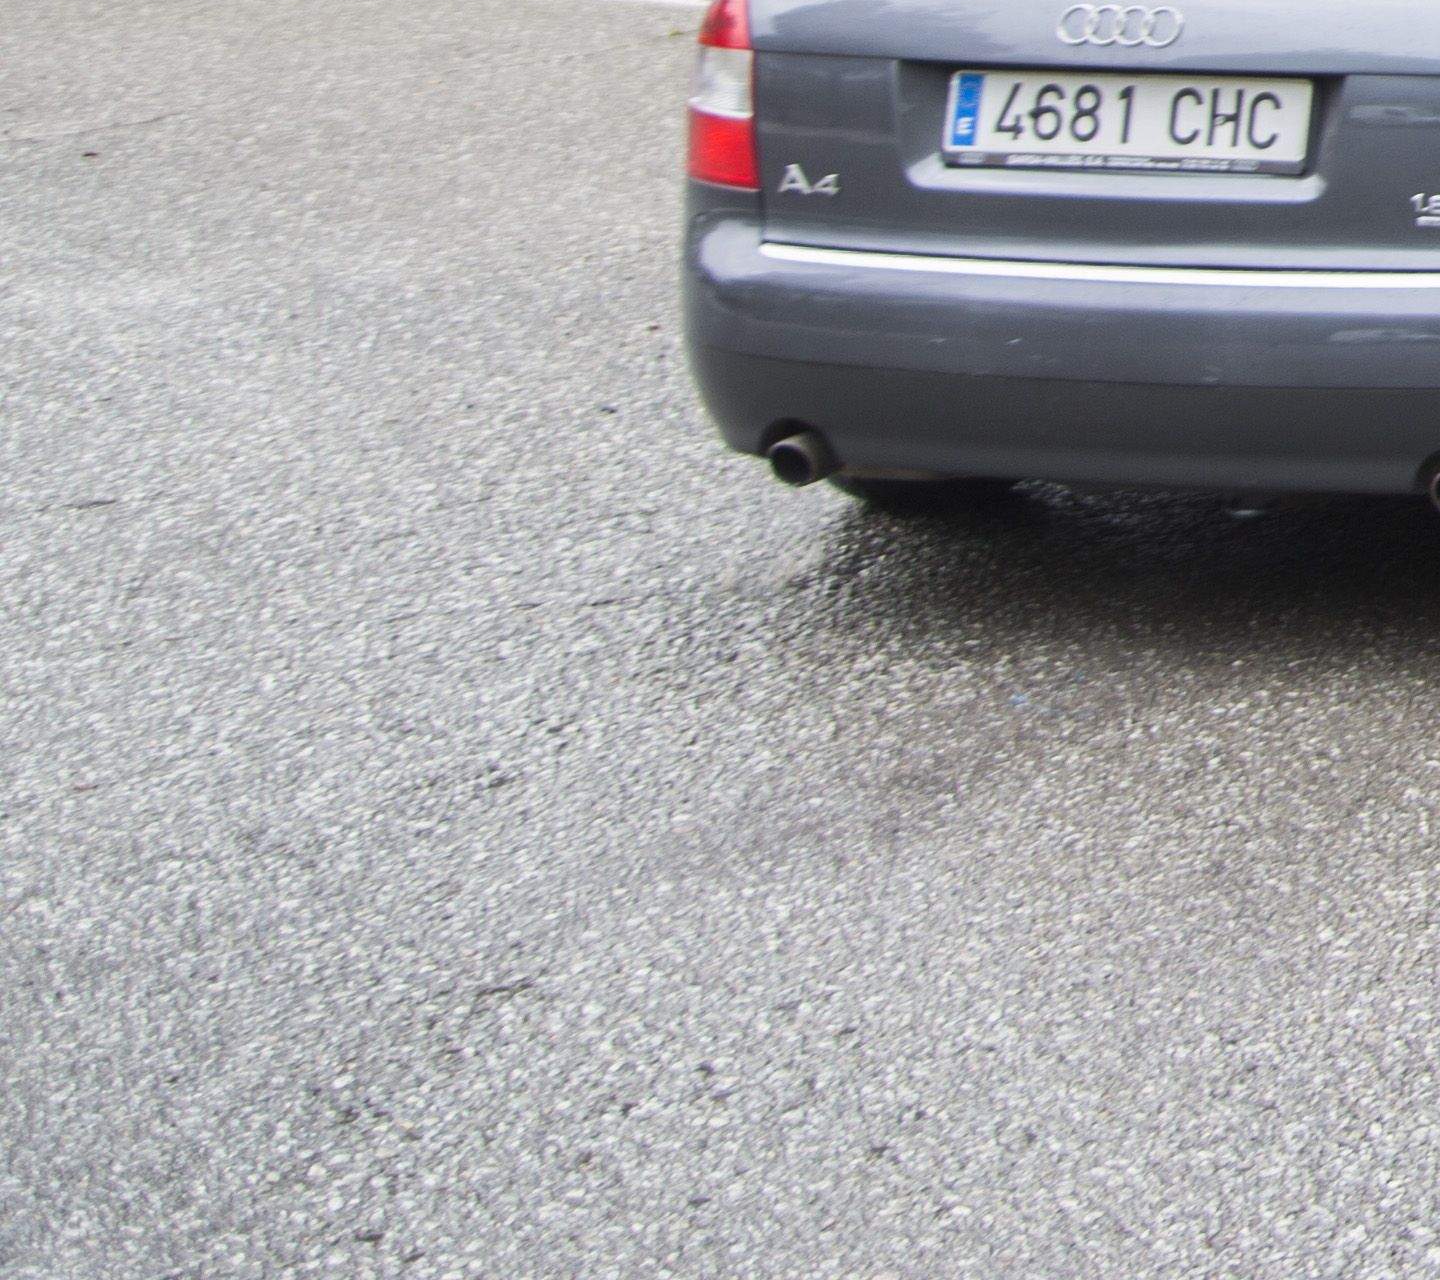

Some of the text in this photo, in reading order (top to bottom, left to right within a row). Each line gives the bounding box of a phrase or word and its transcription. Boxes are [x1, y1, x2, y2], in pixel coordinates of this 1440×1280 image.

[995, 82, 1135, 144] 4681
[1169, 86, 1283, 149] CHC
[777, 163, 842, 195] A4
